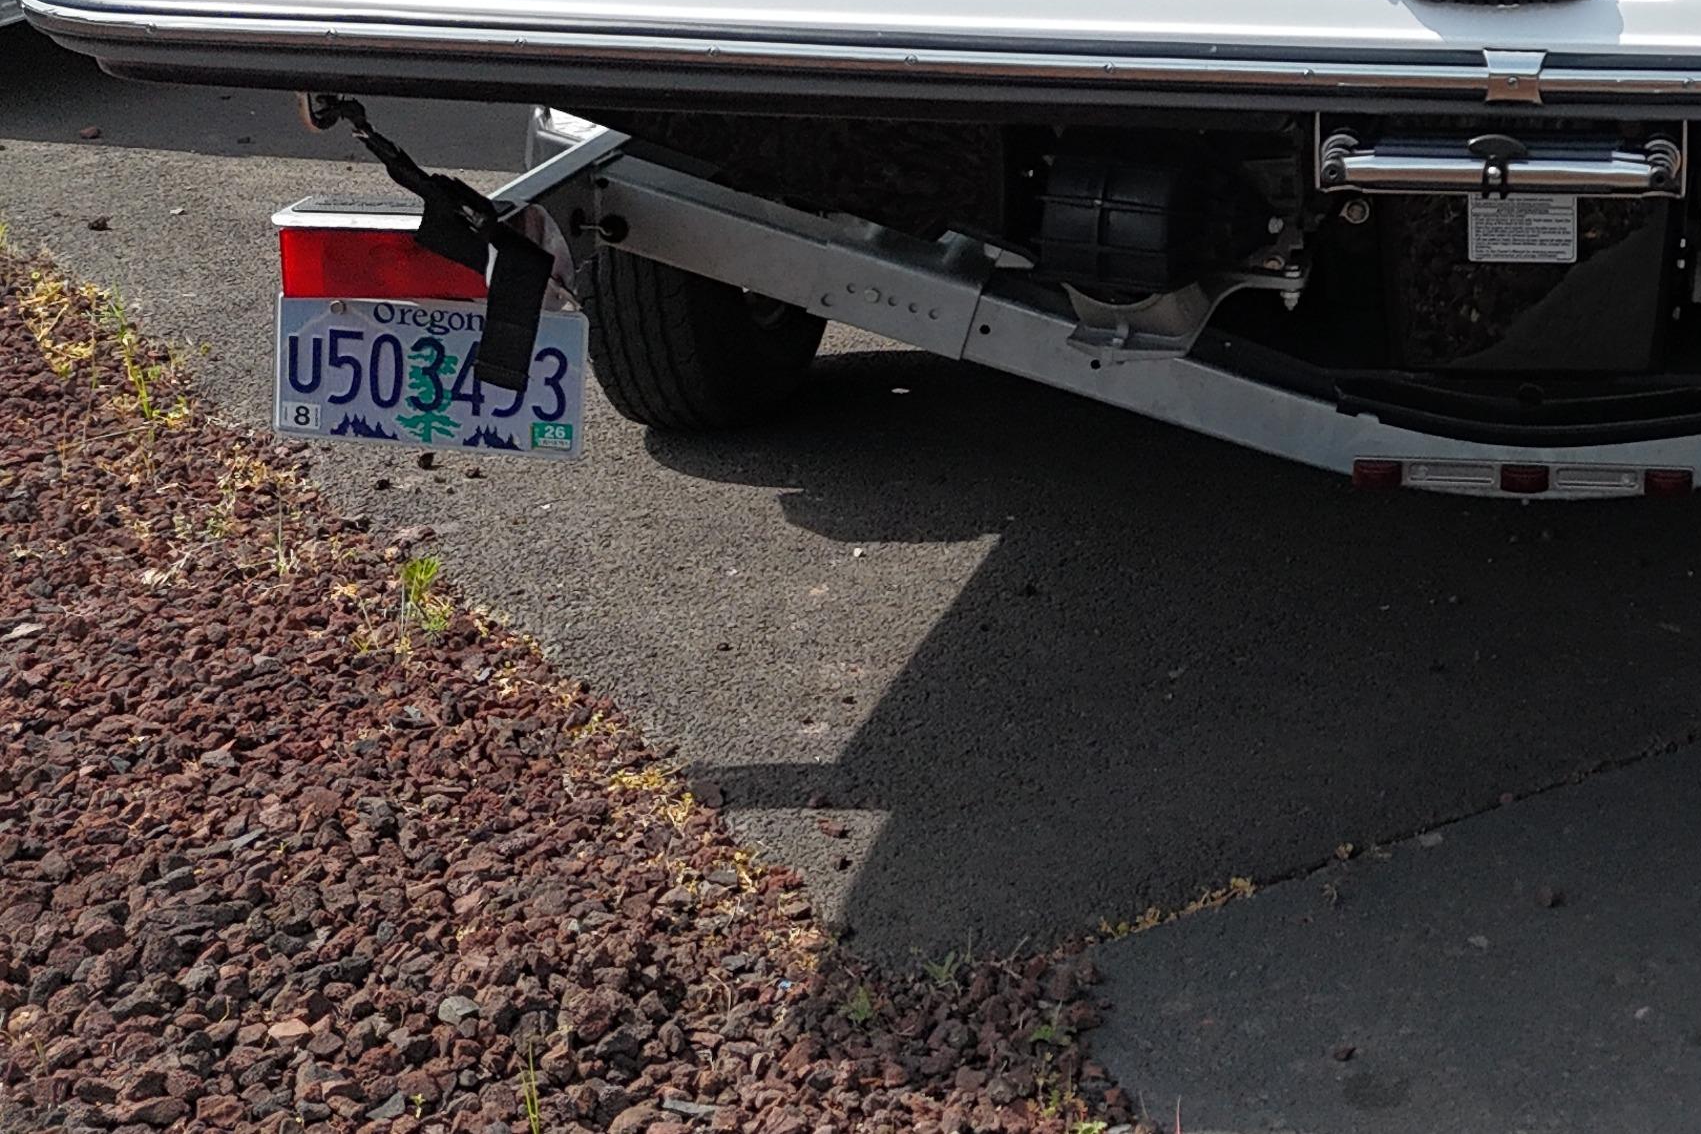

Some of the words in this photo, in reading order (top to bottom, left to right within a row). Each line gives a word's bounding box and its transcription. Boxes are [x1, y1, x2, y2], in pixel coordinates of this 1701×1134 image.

[373, 302, 485, 336] Oregon
[294, 405, 310, 426] 8
[544, 425, 566, 439] 26
